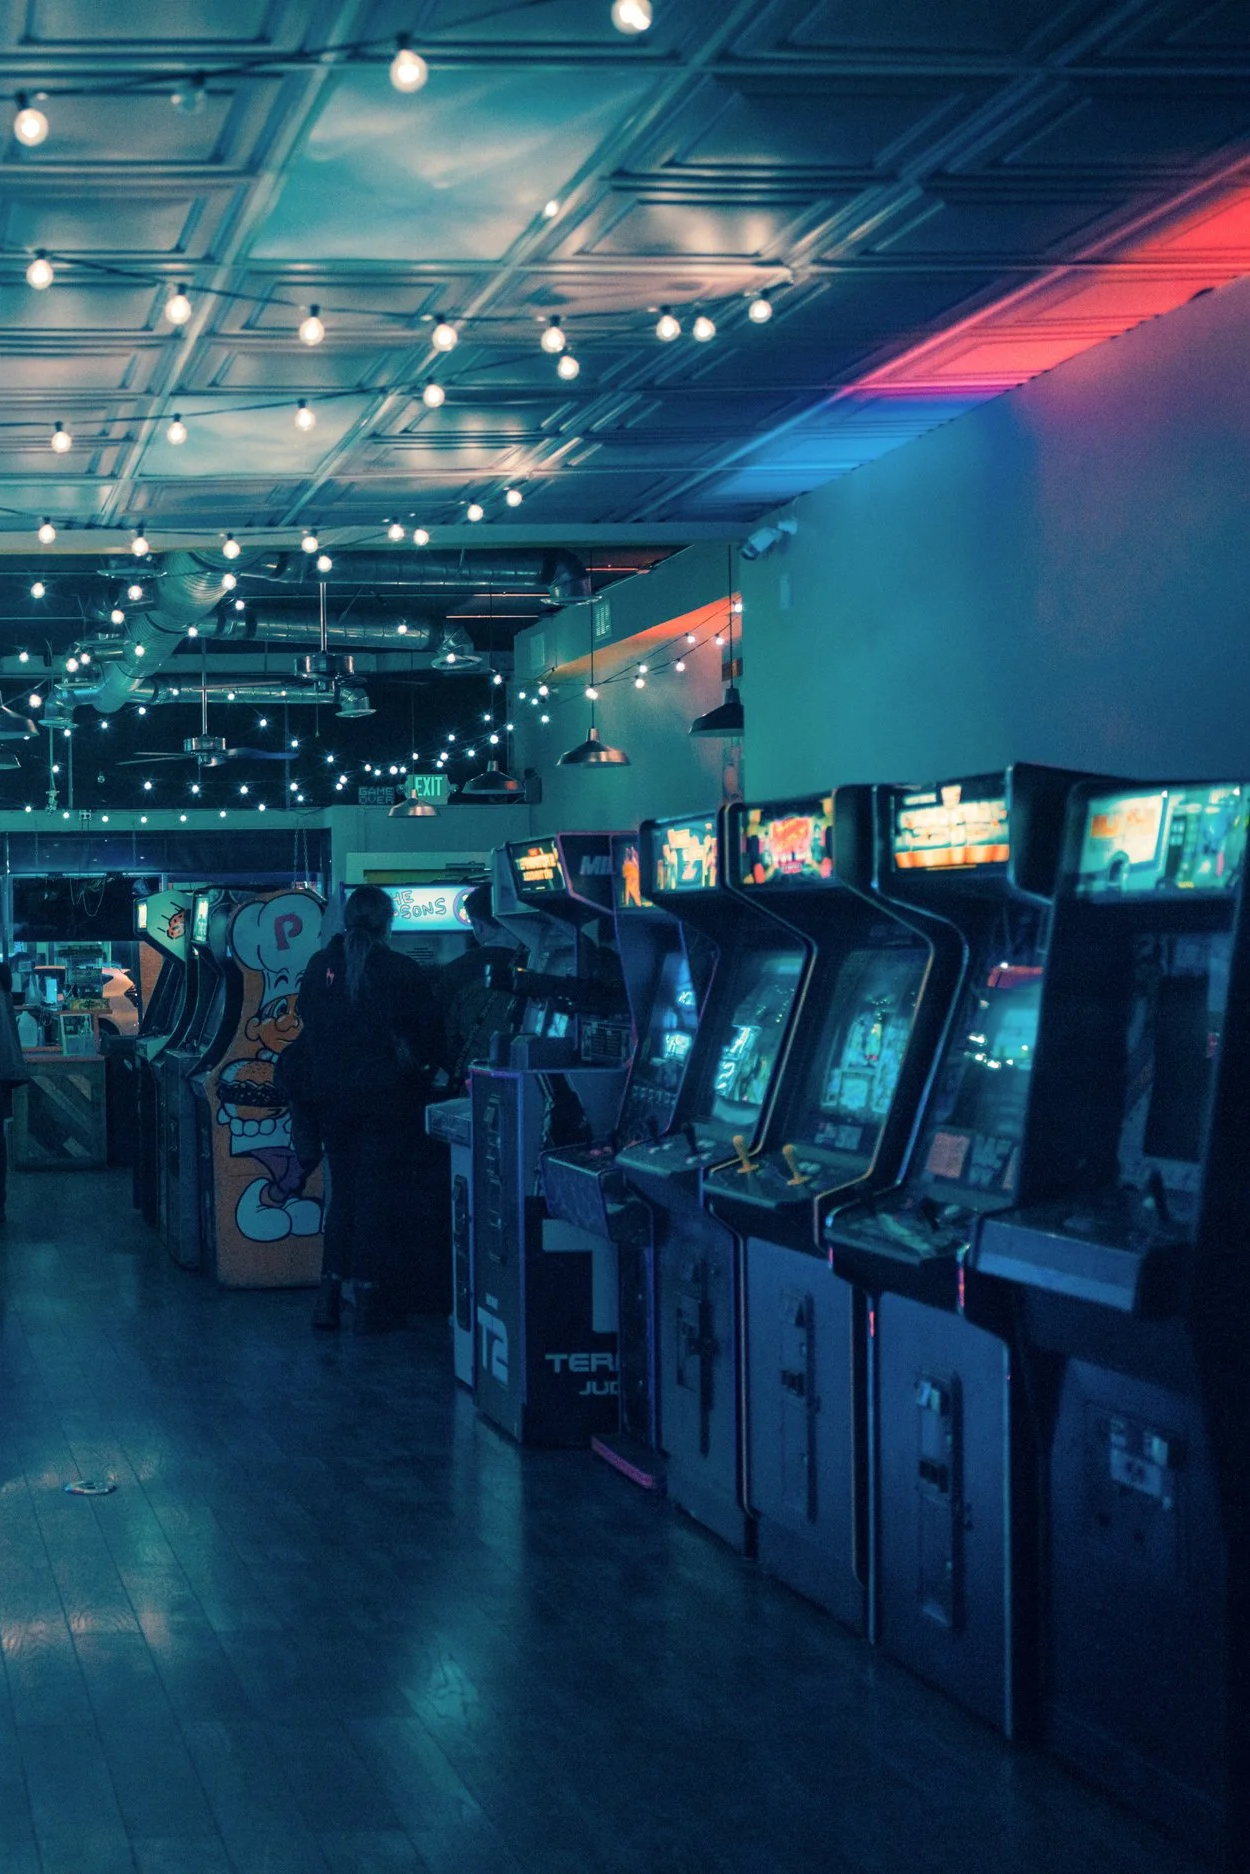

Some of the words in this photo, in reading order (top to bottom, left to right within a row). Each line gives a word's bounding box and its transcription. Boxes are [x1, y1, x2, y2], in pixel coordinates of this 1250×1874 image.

[358, 787, 395, 796] GAME
[414, 776, 443, 797] EXIT
[358, 796, 395, 805] OVER
[393, 890, 414, 906] HE
[393, 897, 447, 919] SONS
[274, 912, 303, 951] P
